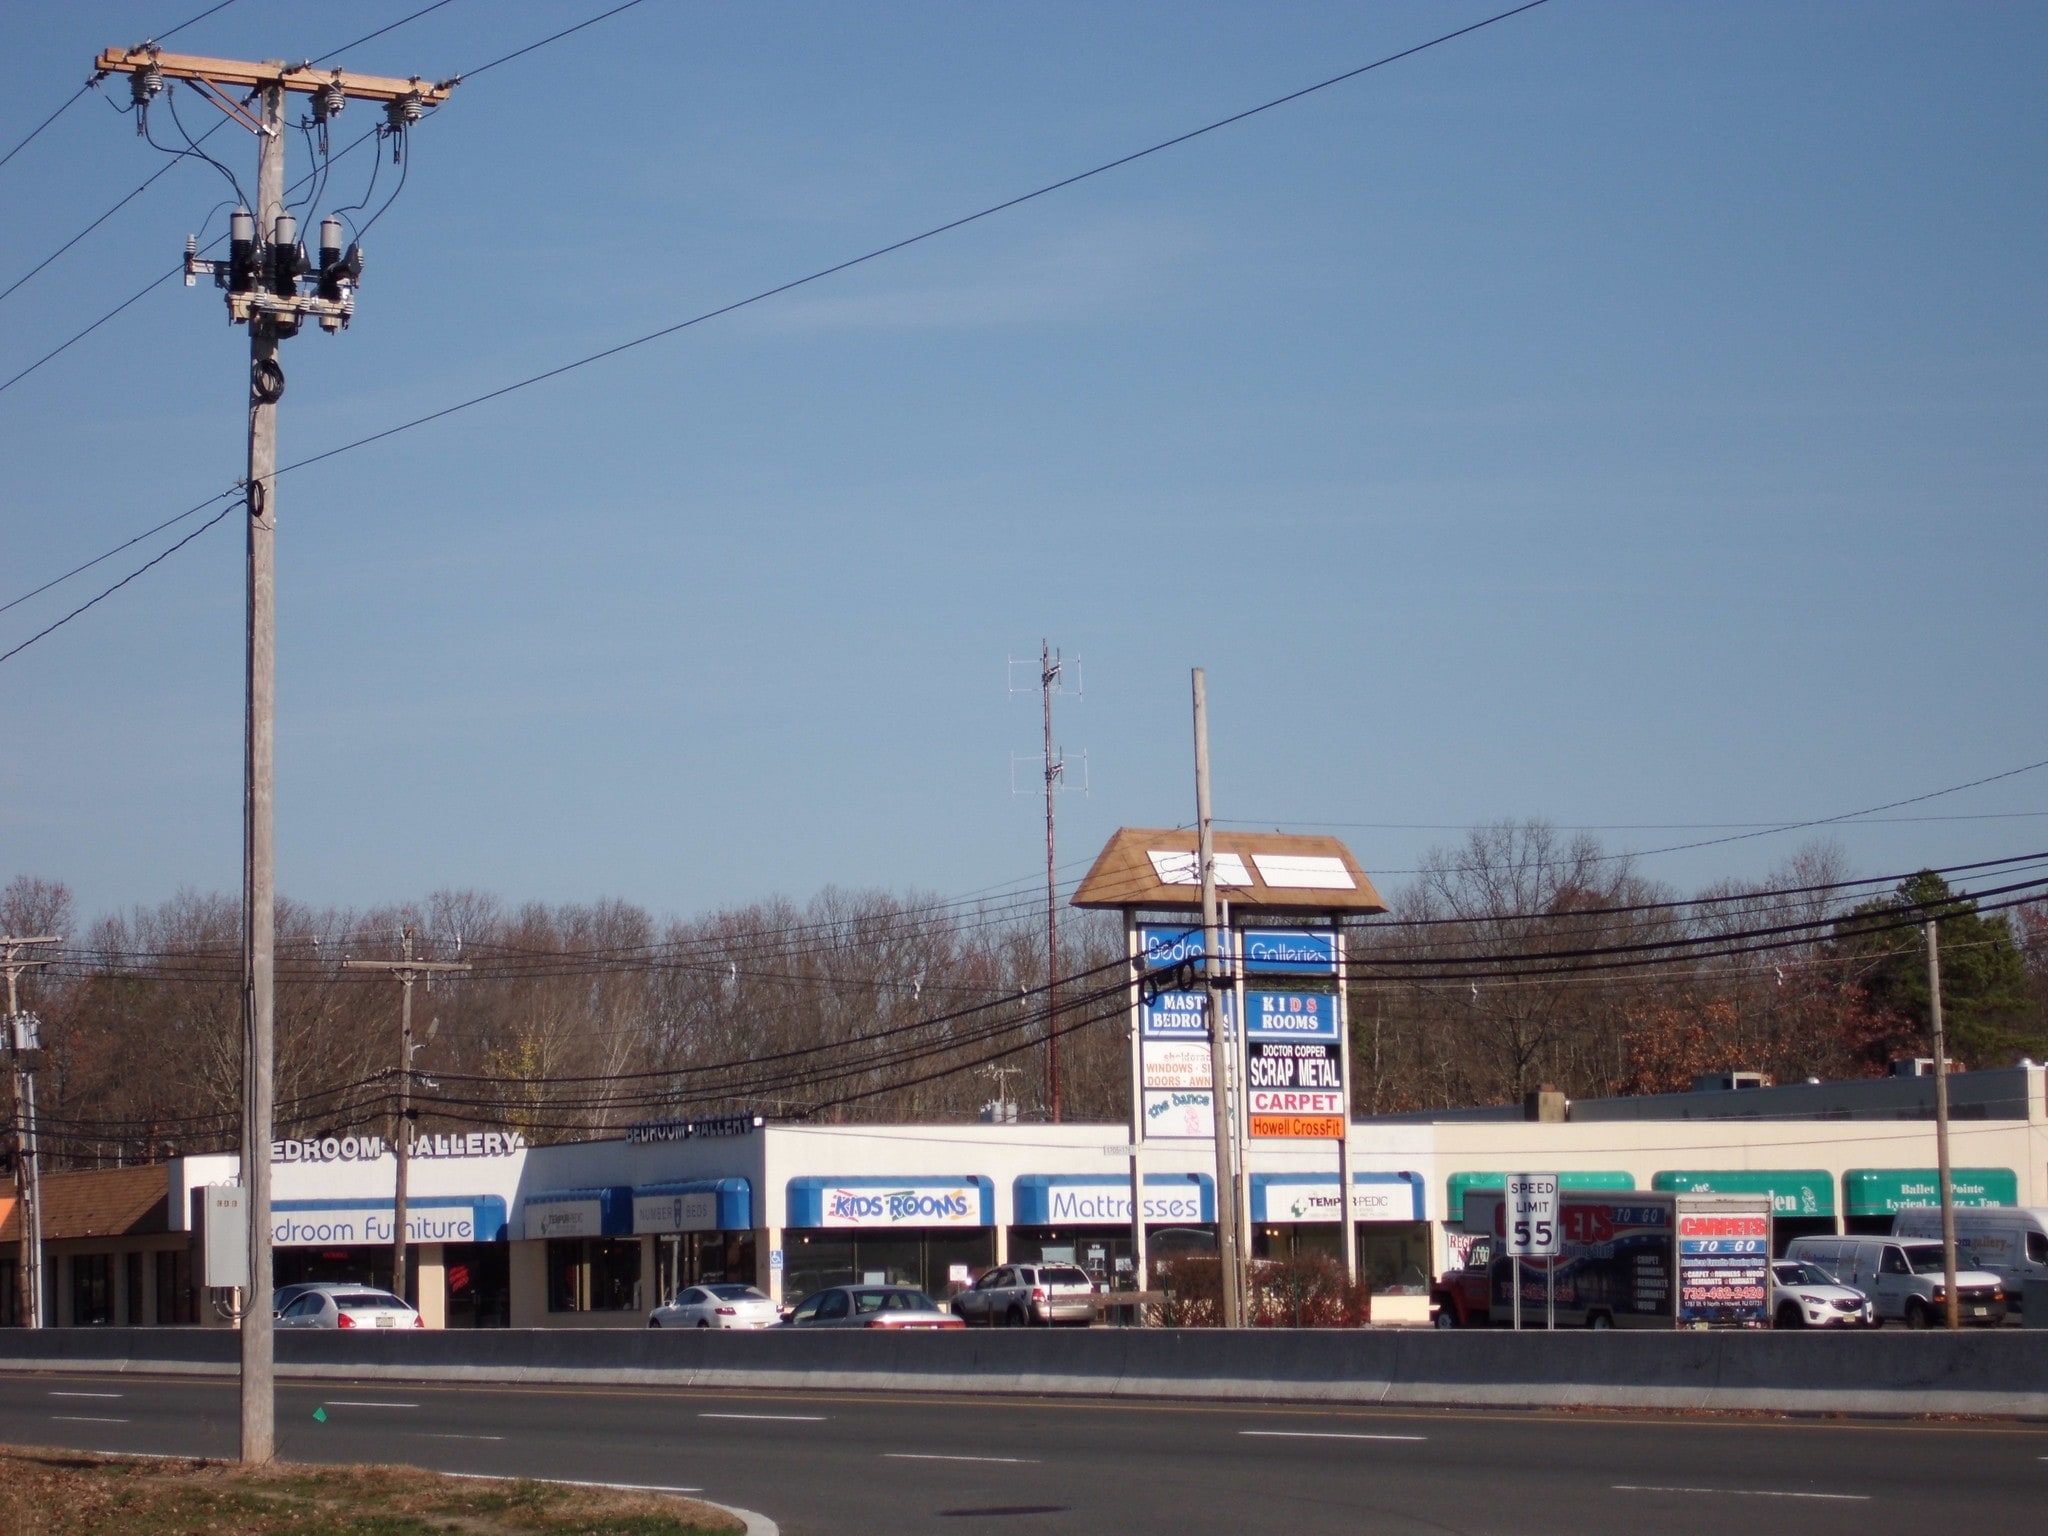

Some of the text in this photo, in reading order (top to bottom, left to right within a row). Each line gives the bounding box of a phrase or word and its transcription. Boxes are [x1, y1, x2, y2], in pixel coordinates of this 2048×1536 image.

[1251, 943, 1327, 961] Galleries
[1262, 1015, 1318, 1030] ROOMS
[1263, 1045, 1326, 1058] DOCTOR COPPER
[1147, 1064, 1192, 1073] WINDOWS
[1250, 1058, 1340, 1087] SCRAP METAL
[1148, 1076, 1180, 1087] DOORS
[1148, 1093, 1209, 1118] the dance
[1255, 1094, 1337, 1111] CARPET
[1253, 1119, 1340, 1136] Howell CrossFit
[271, 1137, 381, 1160] EDROOM
[1511, 1183, 1553, 1194] SPEED
[1901, 1183, 1984, 1195] Ballet Pointe
[835, 1195, 967, 1218] KIDS ROOMS
[1516, 1202, 1549, 1213] LIMIT
[1886, 1198, 1927, 1209] Lyrical
[639, 1204, 708, 1221] NUMBER BEDS
[1616, 1209, 1658, 1222] TO GO
[366, 1217, 472, 1240] Funiture
[1514, 1221, 1553, 1246] 55
[1681, 1218, 1766, 1236] CARPETS
[1699, 1241, 1756, 1251] TO GO
